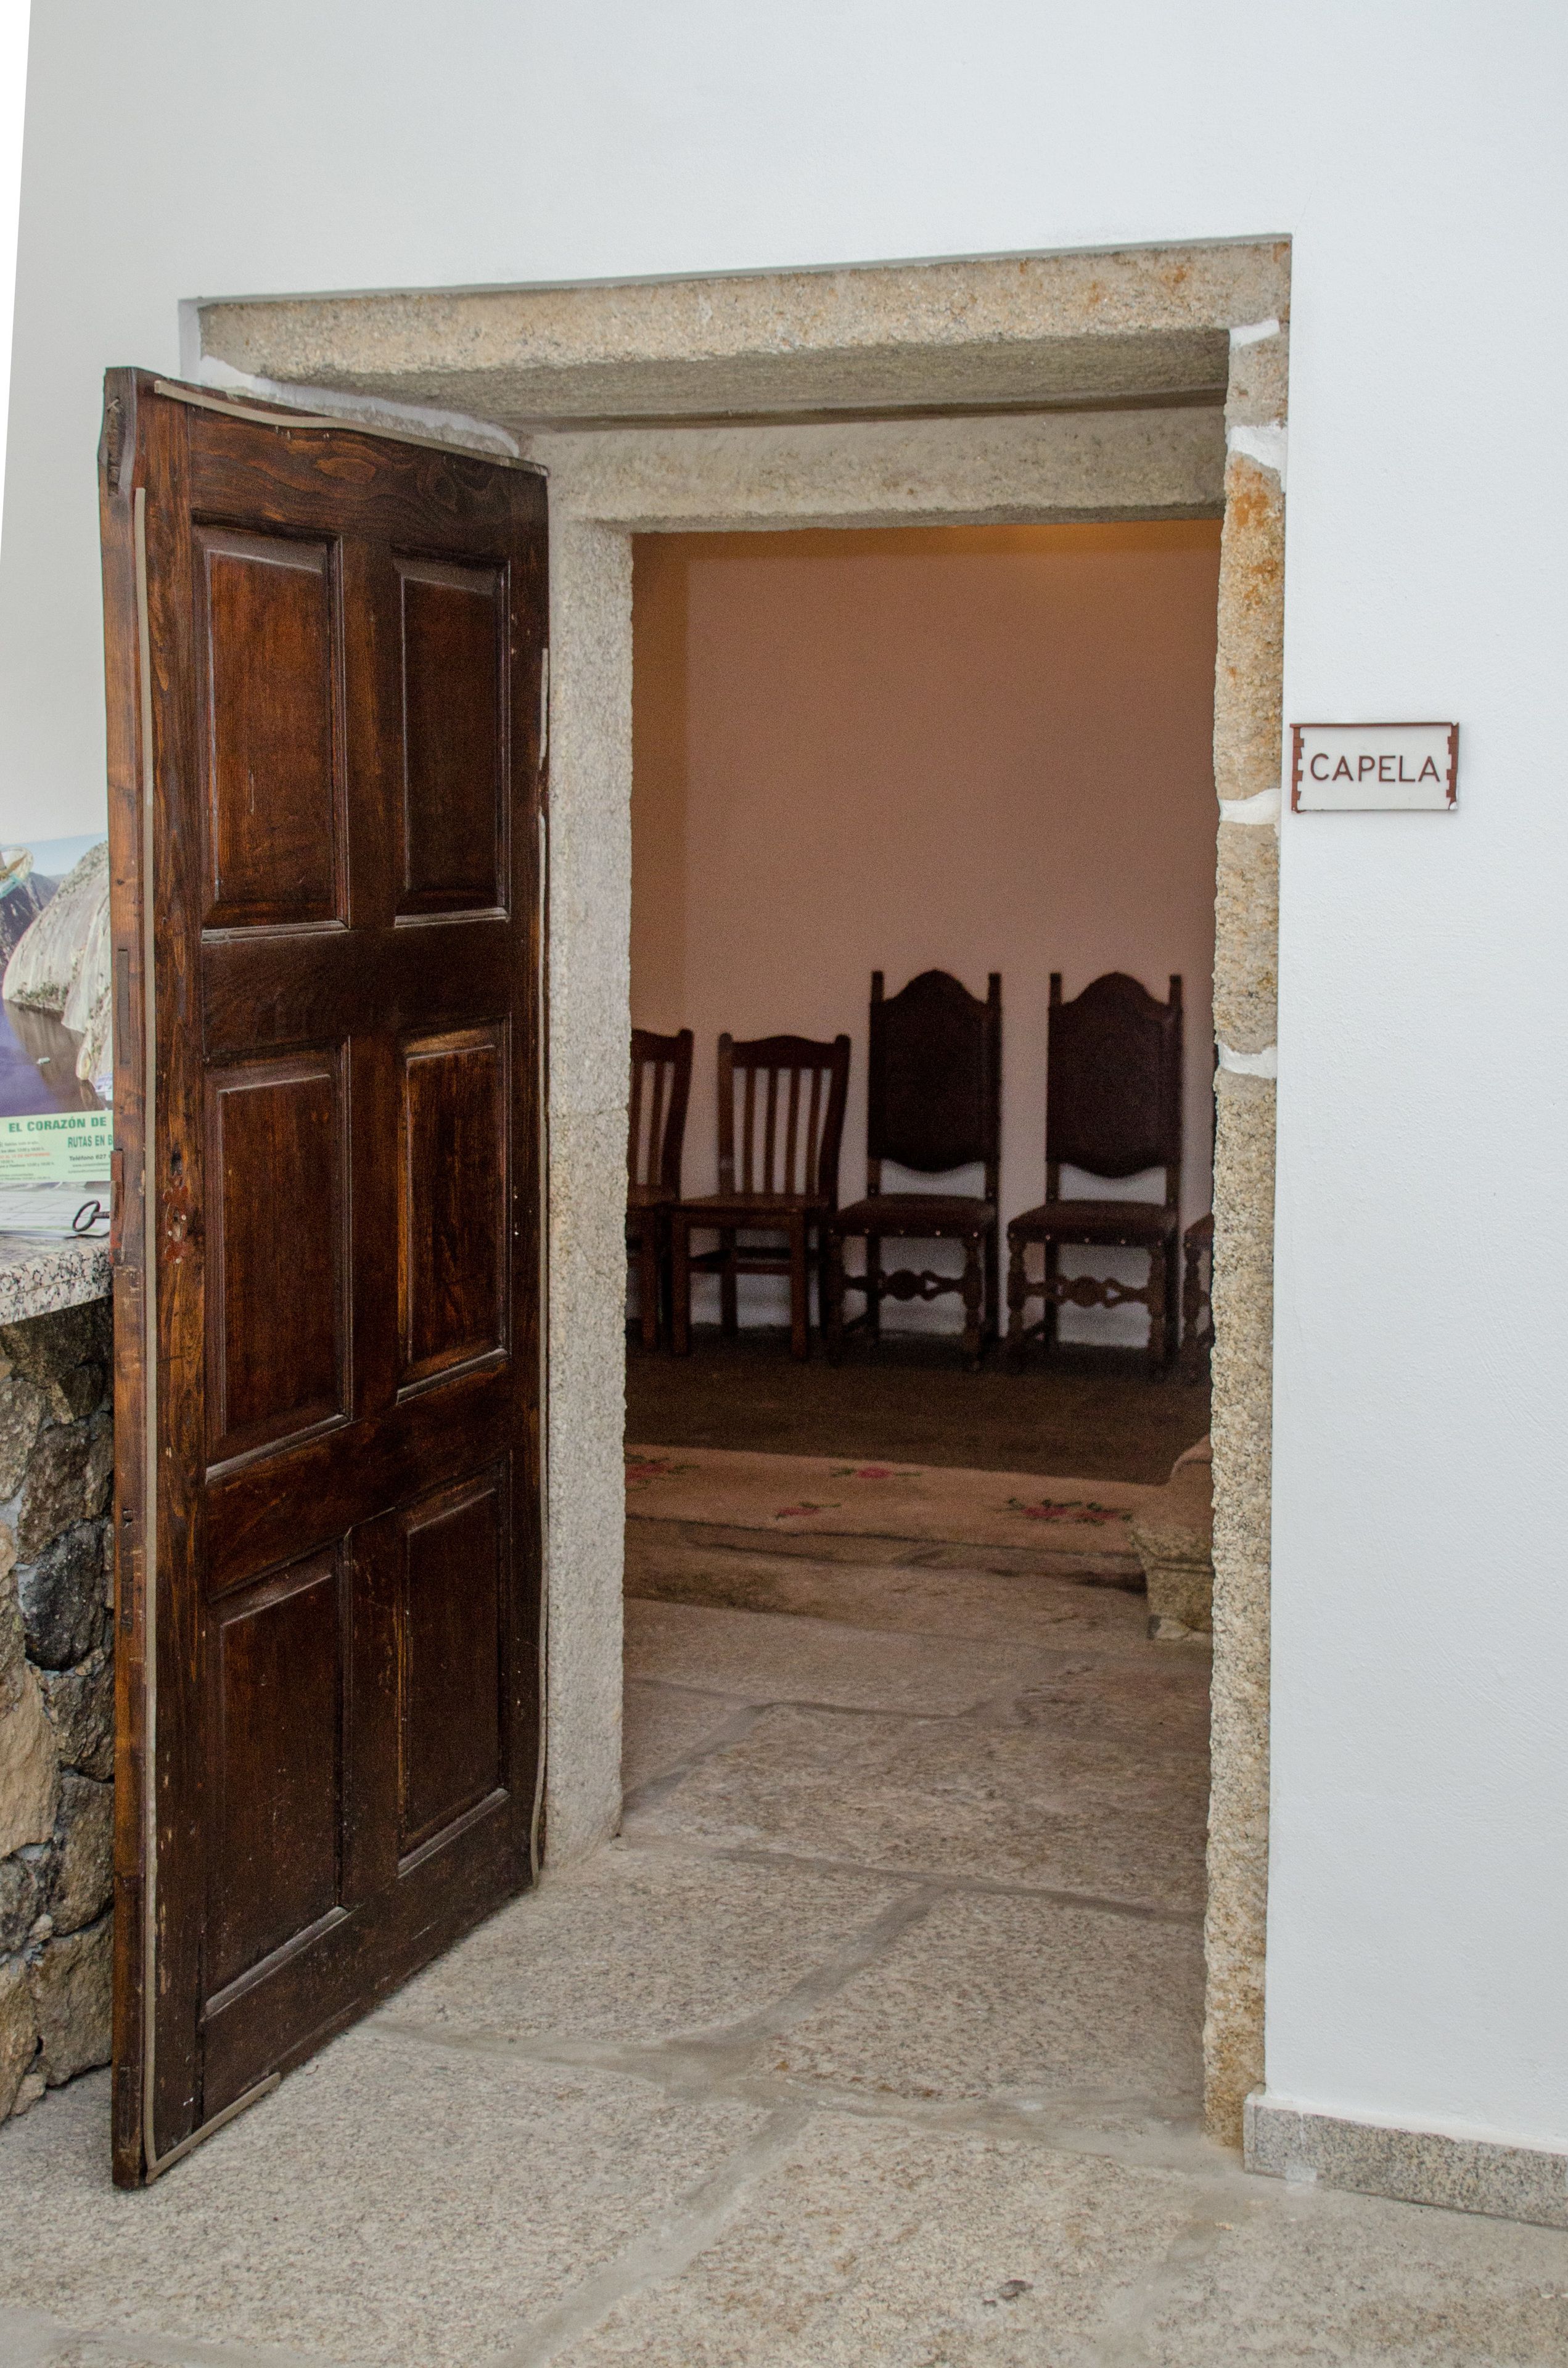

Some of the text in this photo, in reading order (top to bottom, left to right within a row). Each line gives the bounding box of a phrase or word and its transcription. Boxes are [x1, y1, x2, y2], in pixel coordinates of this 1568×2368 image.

[1310, 752, 1441, 783] CAPELA
[9, 1122, 22, 1133] EL
[27, 1116, 86, 1132] CORAZÓN
[91, 1117, 107, 1127] DE
[68, 1136, 92, 1148] RUTAS
[95, 1135, 105, 1146] EN
